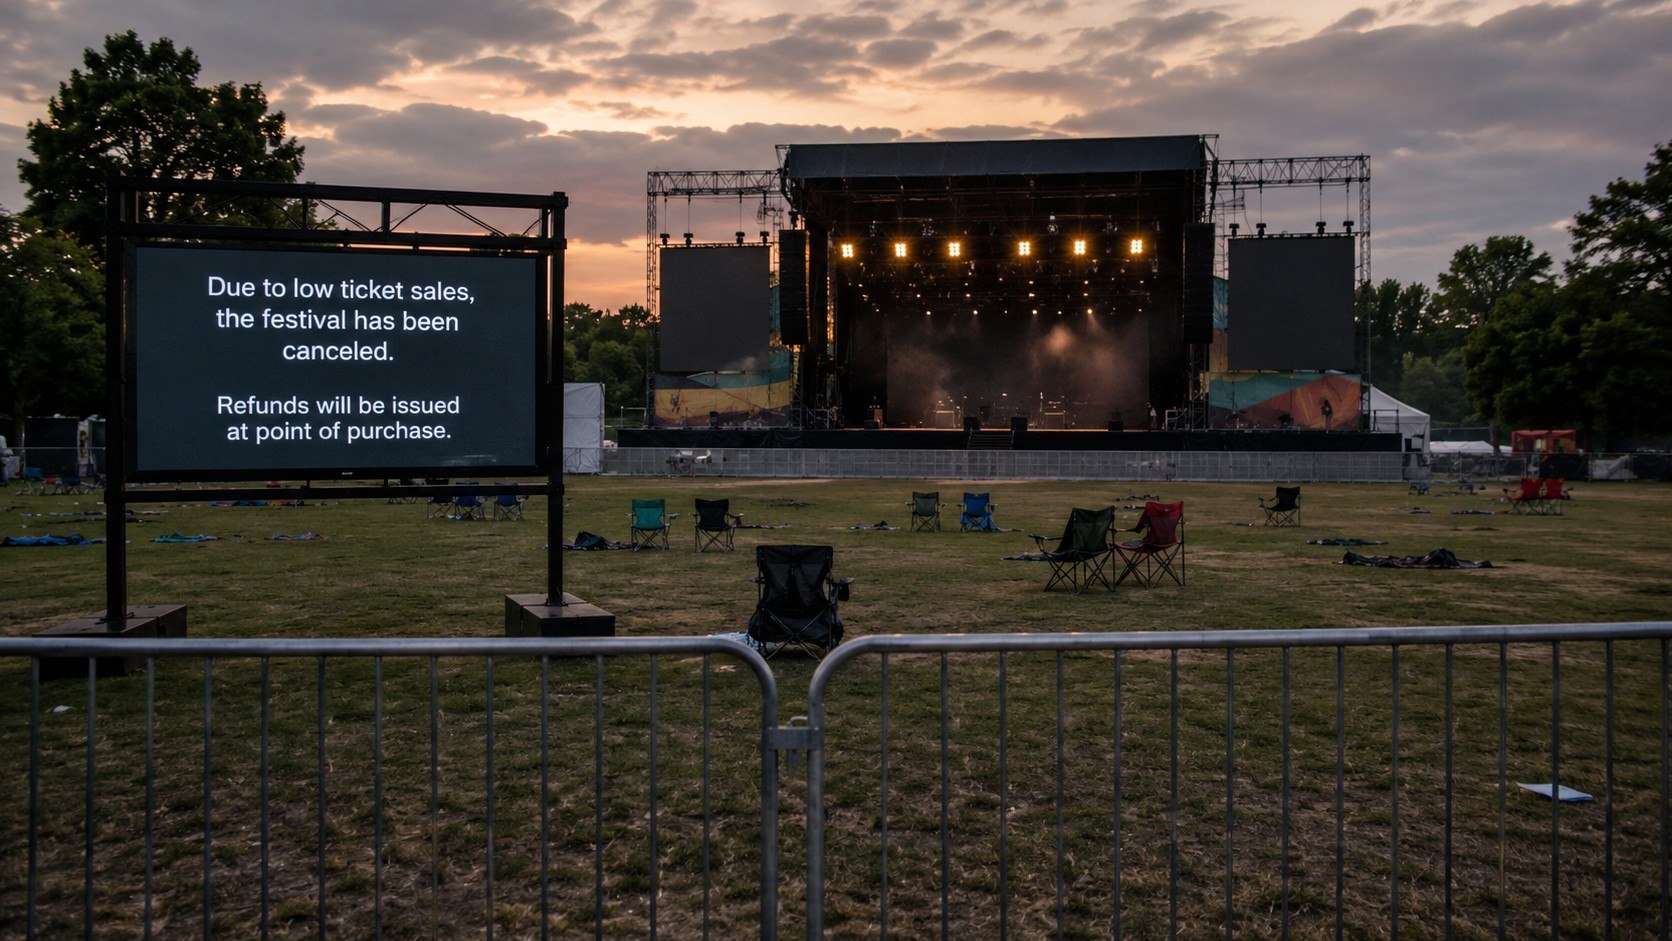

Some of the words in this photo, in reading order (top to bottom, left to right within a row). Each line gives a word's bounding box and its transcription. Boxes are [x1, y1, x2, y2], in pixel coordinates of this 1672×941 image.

[209, 276, 255, 296] Due
[263, 279, 286, 297] to
[294, 278, 334, 298] low
[340, 279, 403, 299] ticket
[411, 281, 474, 304] sales,
[216, 308, 254, 328] the
[262, 308, 345, 329] festival
[355, 310, 395, 330] has
[403, 311, 458, 331] been
[283, 341, 393, 360] canceled.
[218, 396, 309, 414] Refunds
[316, 396, 350, 414] will
[359, 396, 385, 414] be
[393, 396, 459, 414] issued
[227, 423, 248, 440] at
[257, 422, 312, 444] point
[319, 421, 340, 439] of
[348, 421, 451, 444] purchase.
